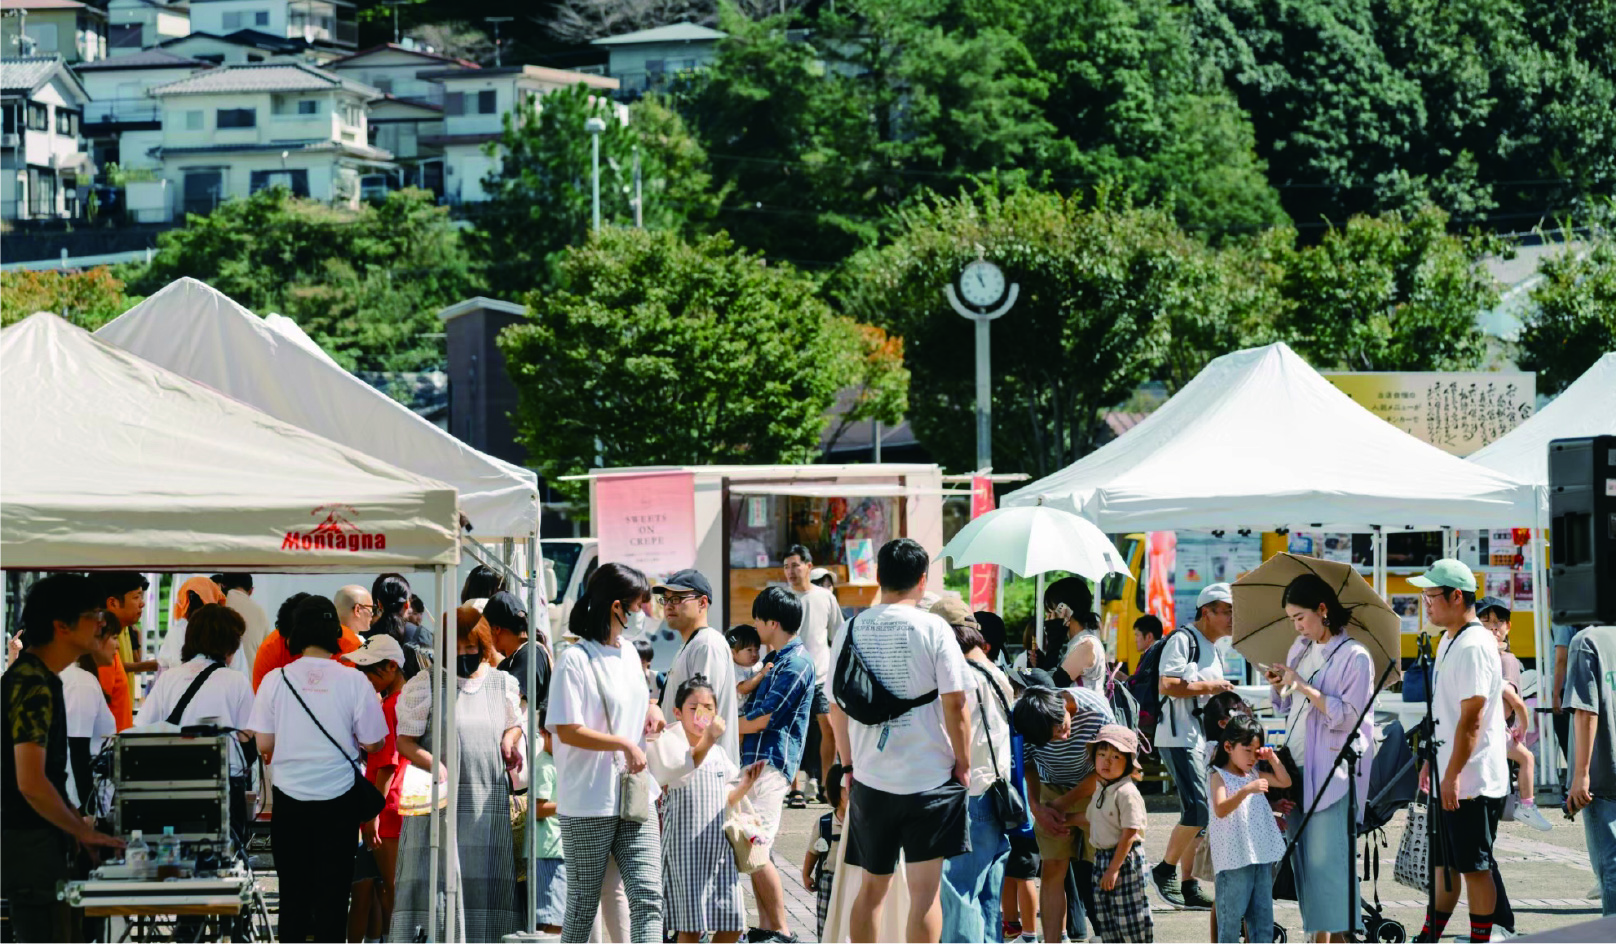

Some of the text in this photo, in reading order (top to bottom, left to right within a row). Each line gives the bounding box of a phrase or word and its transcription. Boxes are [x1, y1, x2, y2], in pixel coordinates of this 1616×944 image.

[626, 514, 666, 523] SWEETS
[638, 525, 655, 534] ON
[281, 531, 386, 552] Montagna
[630, 537, 664, 545] CREPE
